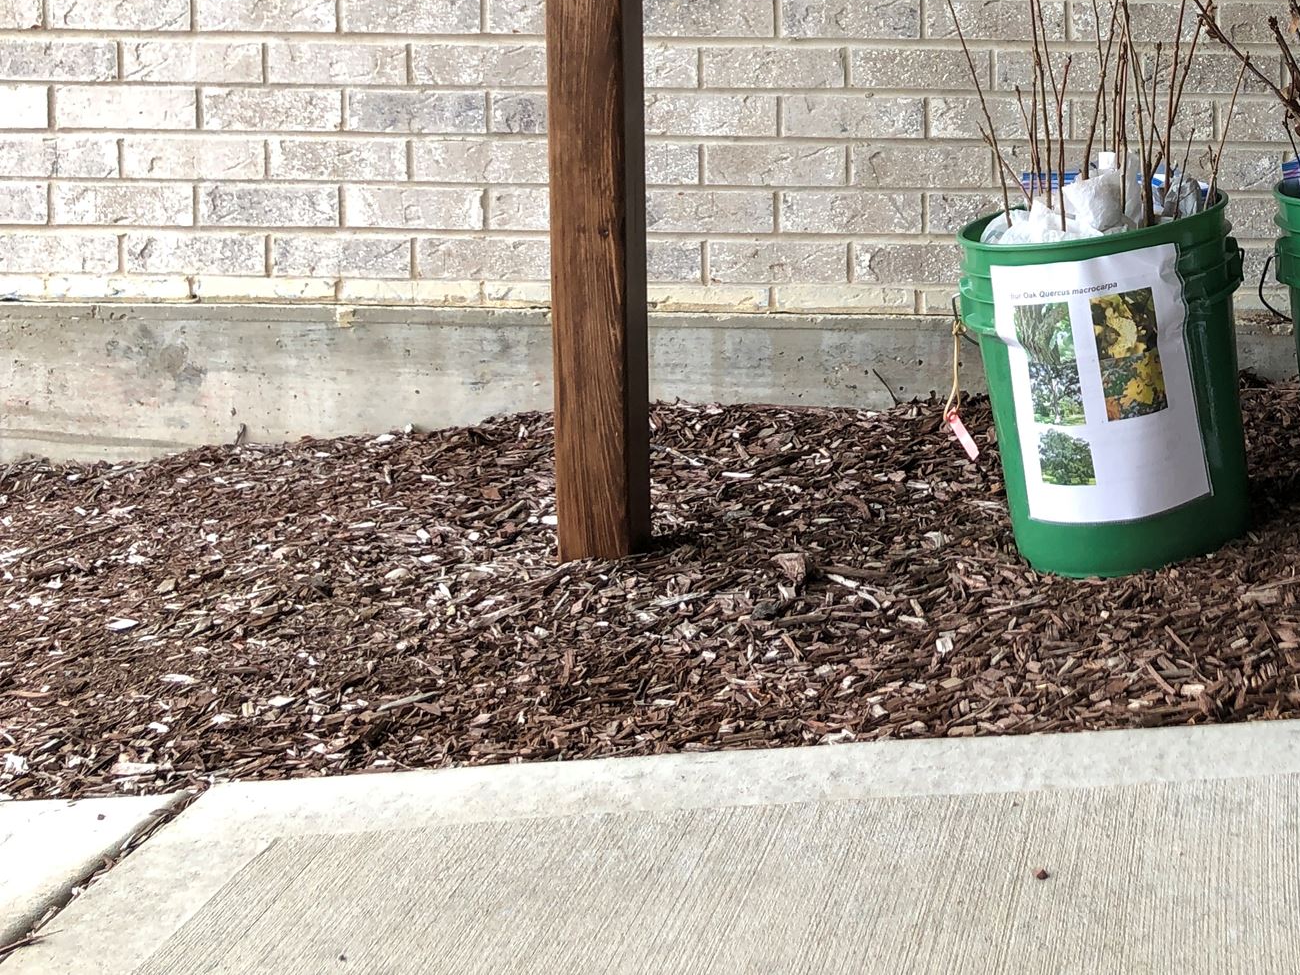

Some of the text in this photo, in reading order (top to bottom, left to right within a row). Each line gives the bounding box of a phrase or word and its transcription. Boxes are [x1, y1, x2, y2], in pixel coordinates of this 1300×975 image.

[1023, 291, 1037, 299] Oak
[1039, 288, 1071, 298] Quercus
[1071, 281, 1118, 295] macrocarpa
